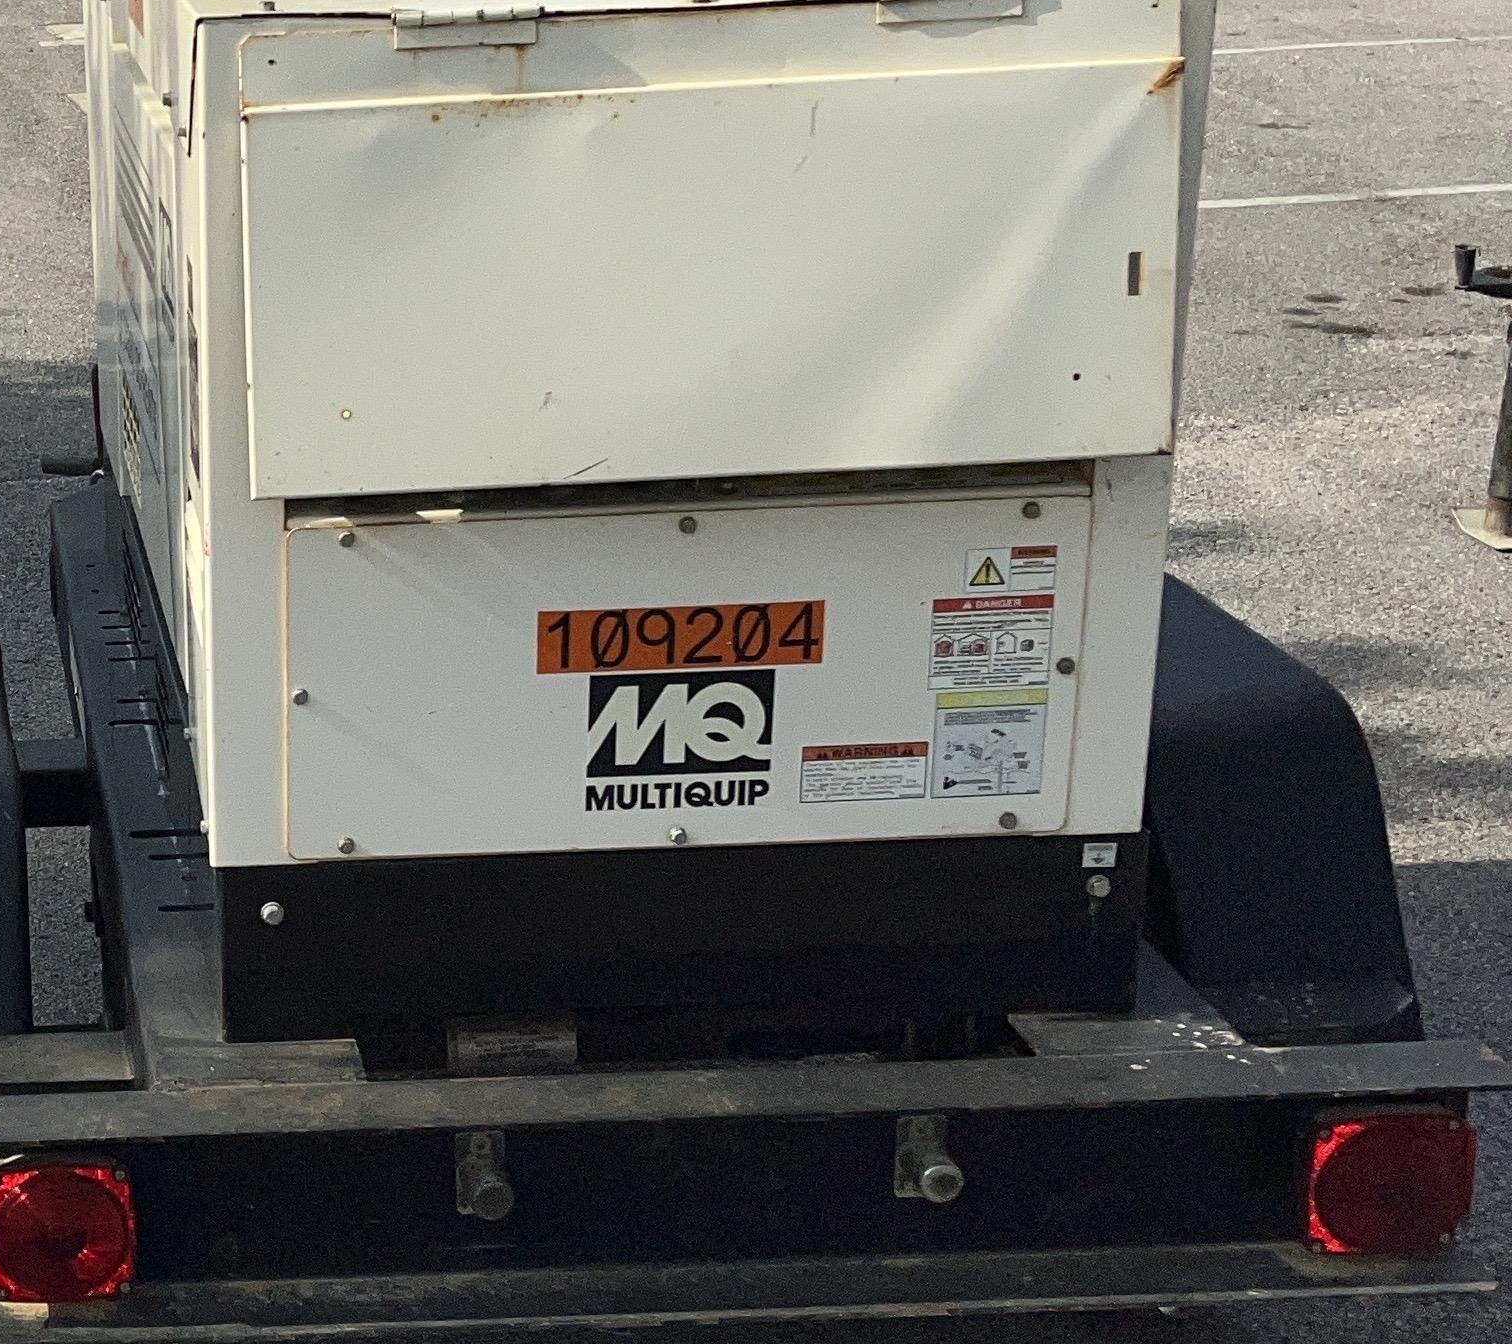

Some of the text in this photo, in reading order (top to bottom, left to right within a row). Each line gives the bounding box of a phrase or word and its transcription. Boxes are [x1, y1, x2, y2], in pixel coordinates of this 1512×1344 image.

[547, 602, 819, 668] 109204
[587, 681, 772, 766] MQ
[831, 745, 899, 758] WARNING
[585, 779, 770, 812] MULTIQUIP
